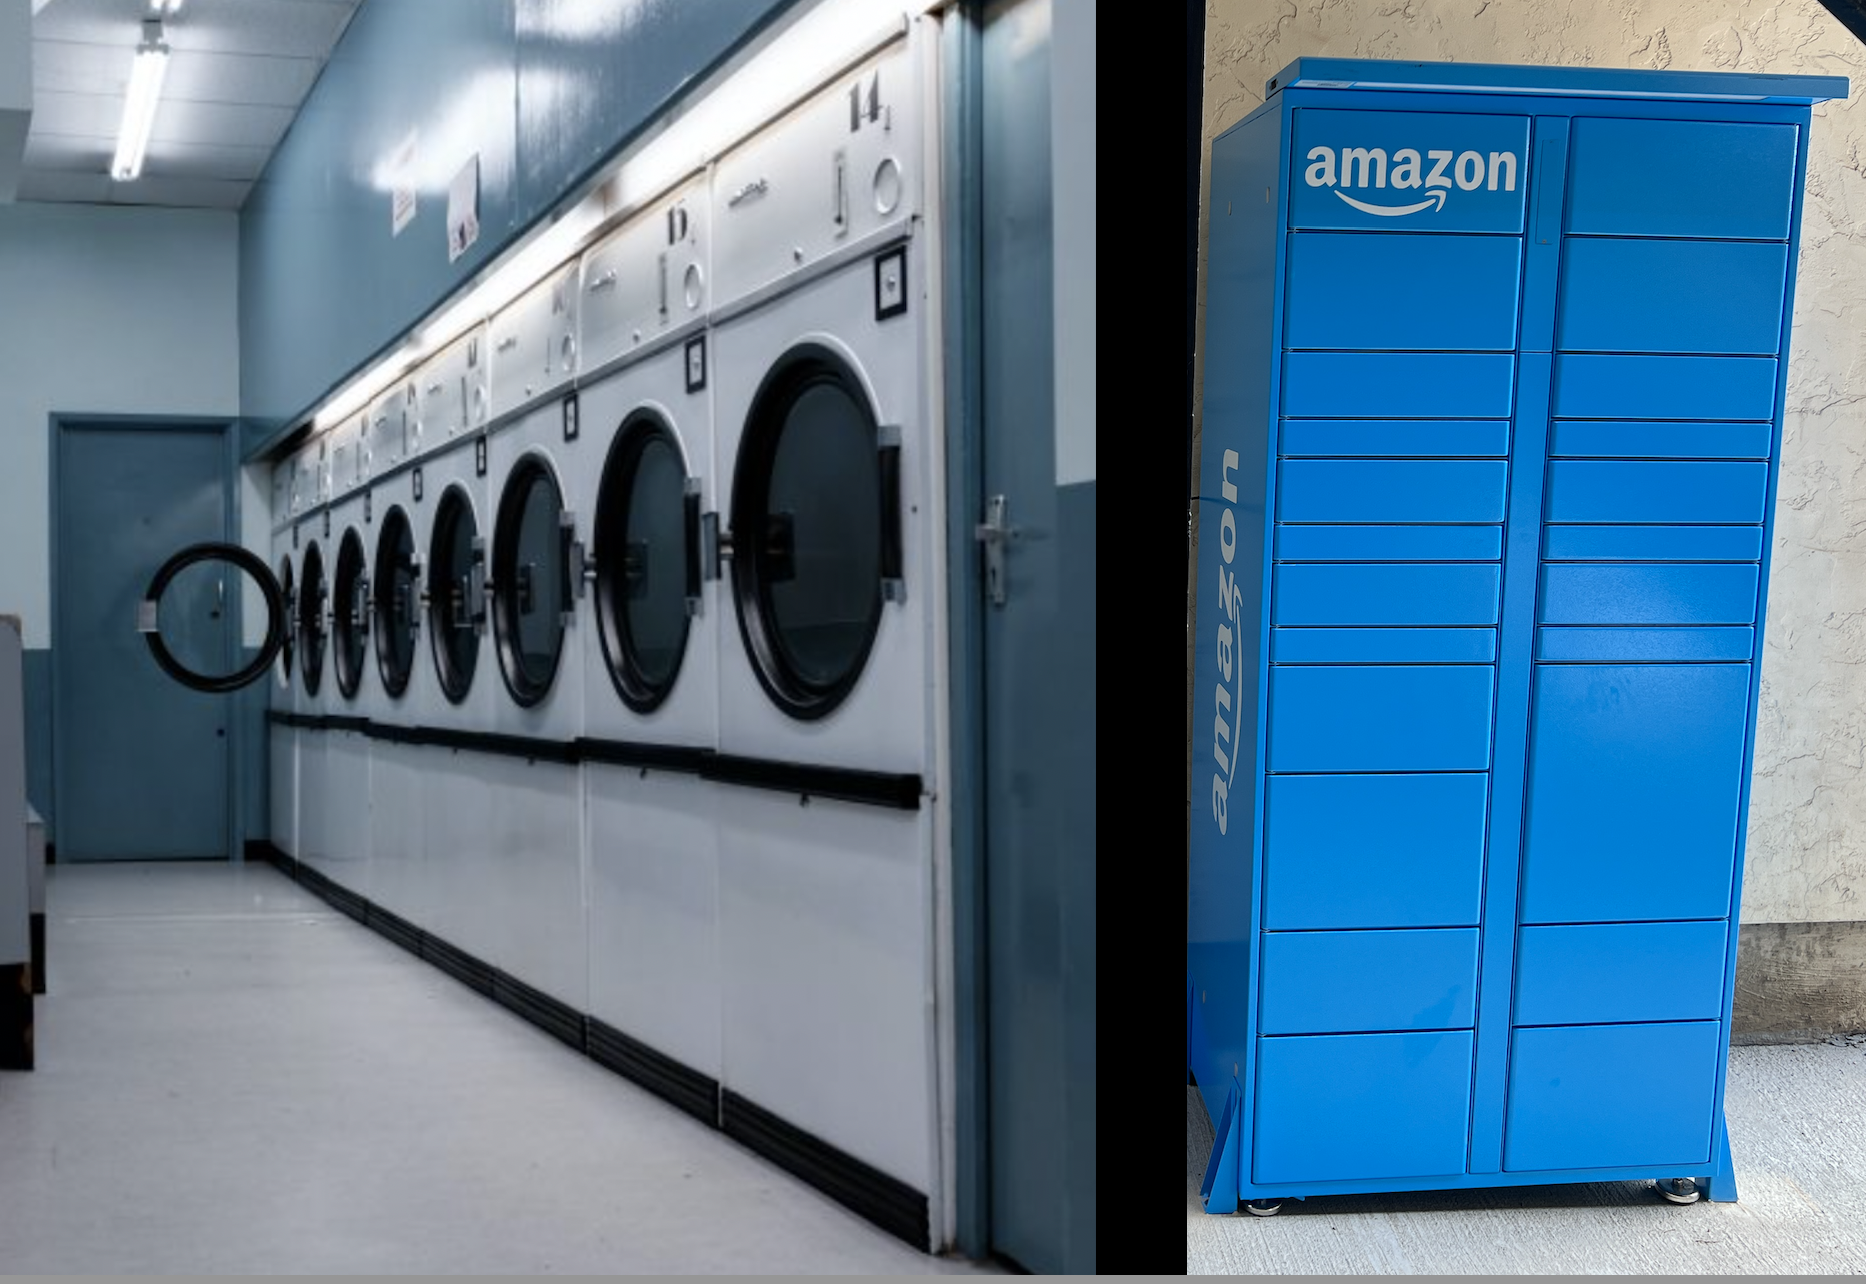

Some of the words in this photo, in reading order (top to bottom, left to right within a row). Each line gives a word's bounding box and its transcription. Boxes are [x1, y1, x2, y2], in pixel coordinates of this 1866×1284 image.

[849, 68, 884, 134] 14
[1304, 145, 1518, 192] amazon
[1212, 448, 1239, 836] amazon
